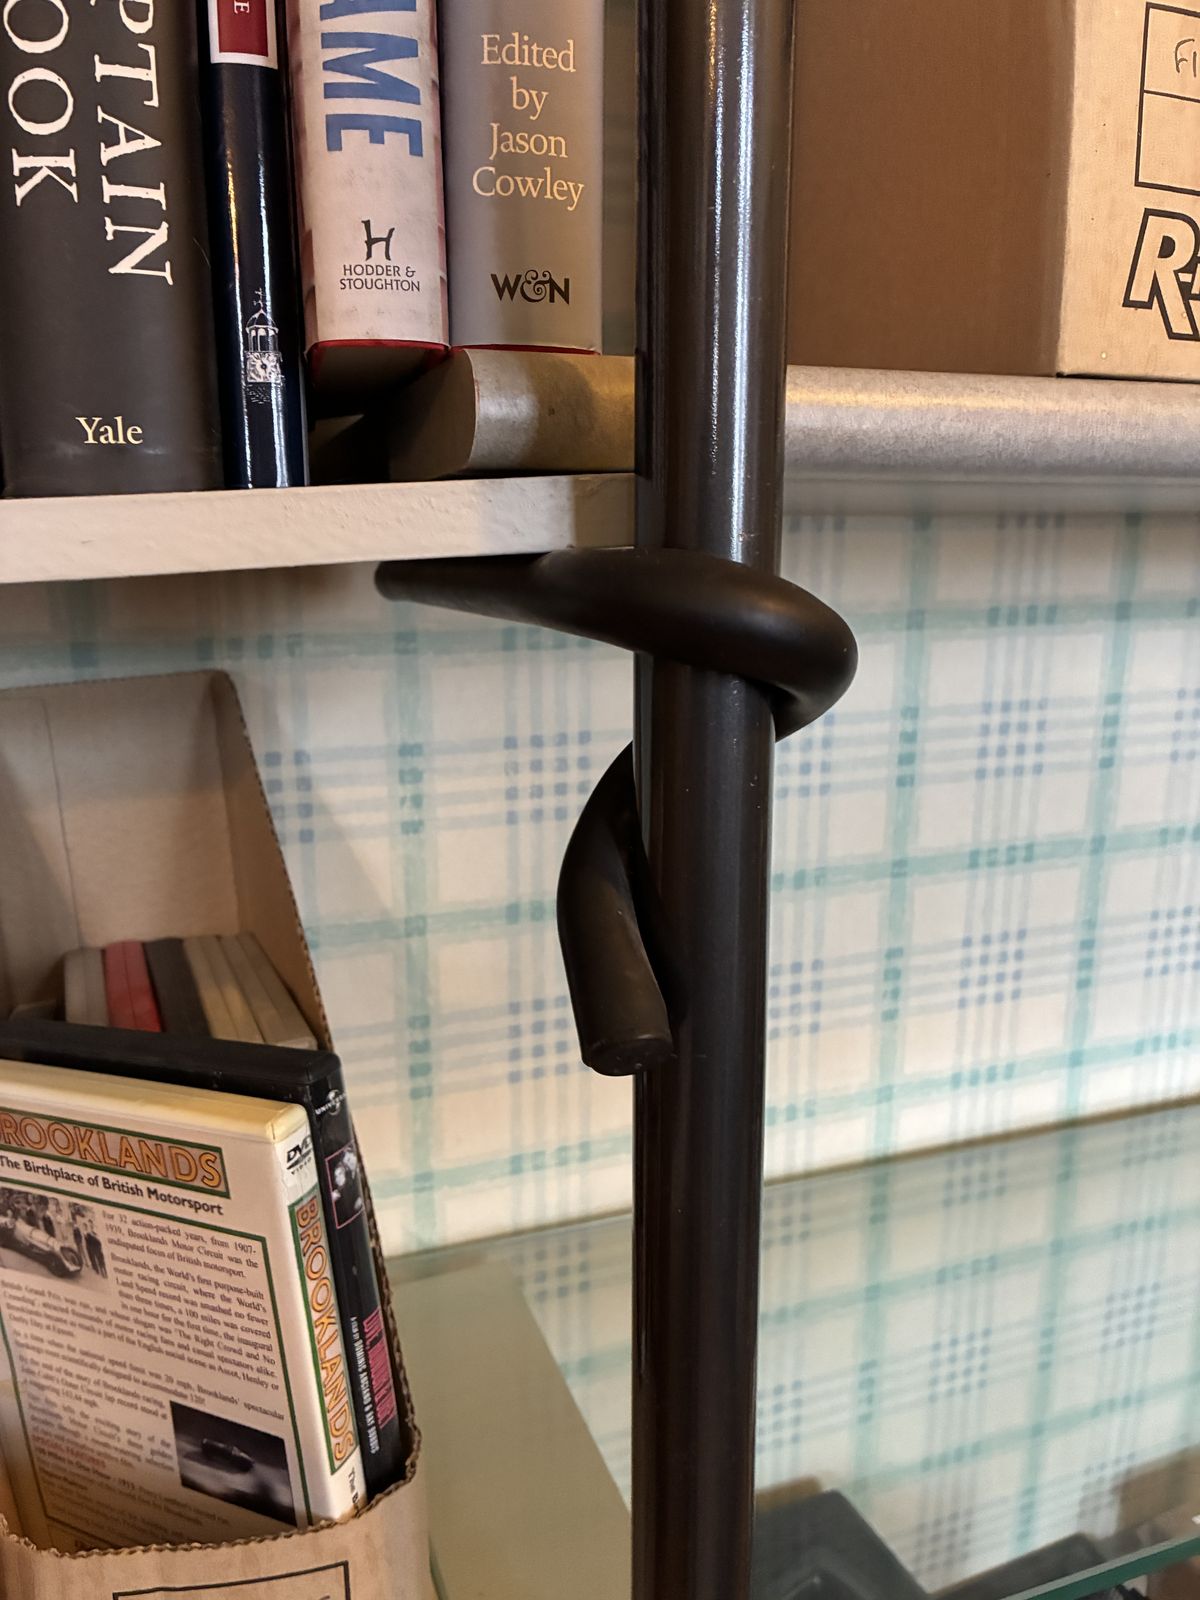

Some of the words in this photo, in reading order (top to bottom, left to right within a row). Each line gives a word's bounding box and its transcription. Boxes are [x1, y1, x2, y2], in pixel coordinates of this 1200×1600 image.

[480, 32, 576, 73] Edited
[509, 76, 549, 120] by
[488, 122, 569, 160] Jason
[472, 166, 585, 211] Cowley
[339, 278, 421, 292] STOUGHTON
[343, 264, 401, 277] HODDER
[405, 266, 416, 278] &
[1122, 207, 1200, 342] R
[490, 269, 570, 305] W&N
[75, 415, 144, 445] Yale
[0, 1155, 21, 1169] The
[23, 1160, 84, 1184] Birthplace
[87, 1175, 100, 1187] of
[102, 1178, 144, 1200] British
[147, 1188, 224, 1216] Motorsport
[166, 1250, 175, 1260] of
[227, 1254, 242, 1264] was
[245, 1256, 258, 1268] the
[153, 1264, 165, 1274] the
[213, 1280, 264, 1302] purpose-built
[192, 1286, 215, 1300] where
[219, 1293, 232, 1304] the
[236, 1298, 266, 1313] World's
[173, 1316, 184, 1327] the
[222, 1330, 235, 1342] the
[184, 1308, 198, 1319] 100
[200, 1312, 220, 1325] miles
[223, 1320, 238, 1330] was
[239, 1323, 271, 1339] covered
[234, 1311, 244, 1320] no
[246, 1312, 268, 1326] fewer
[295, 1196, 355, 1461] BROOKLANDS
[244, 1348, 259, 1360] and
[262, 1354, 275, 1365] No
[270, 1382, 279, 1391] or
